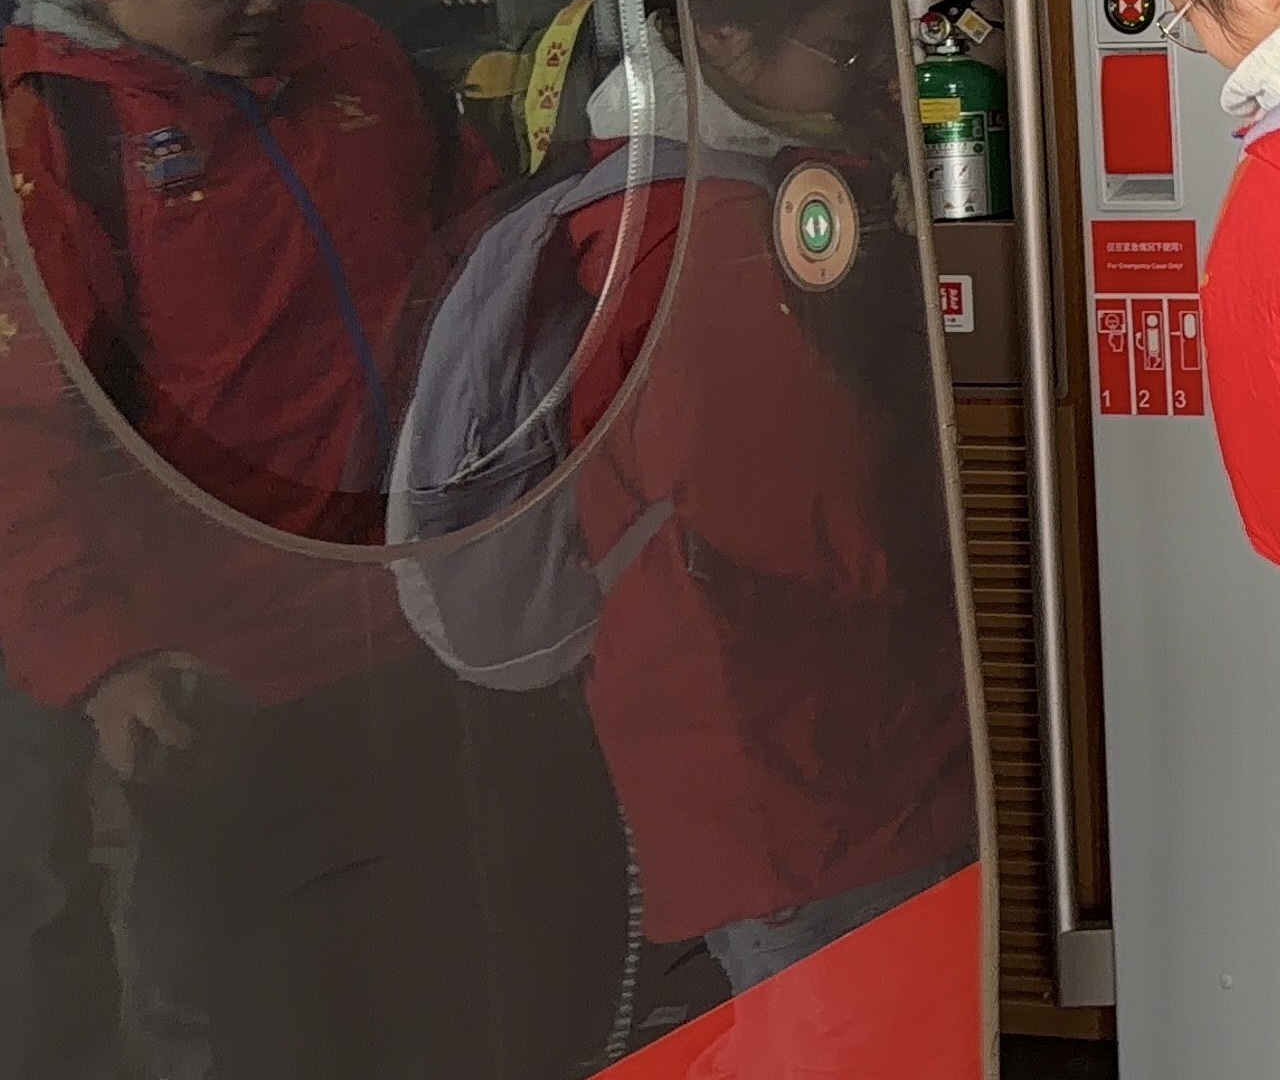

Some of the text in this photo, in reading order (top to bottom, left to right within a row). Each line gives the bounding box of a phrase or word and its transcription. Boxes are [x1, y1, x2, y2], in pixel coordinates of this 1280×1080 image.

[1102, 389, 1111, 408] 1
[1138, 389, 1151, 408] 2
[1174, 389, 1187, 409] 3
